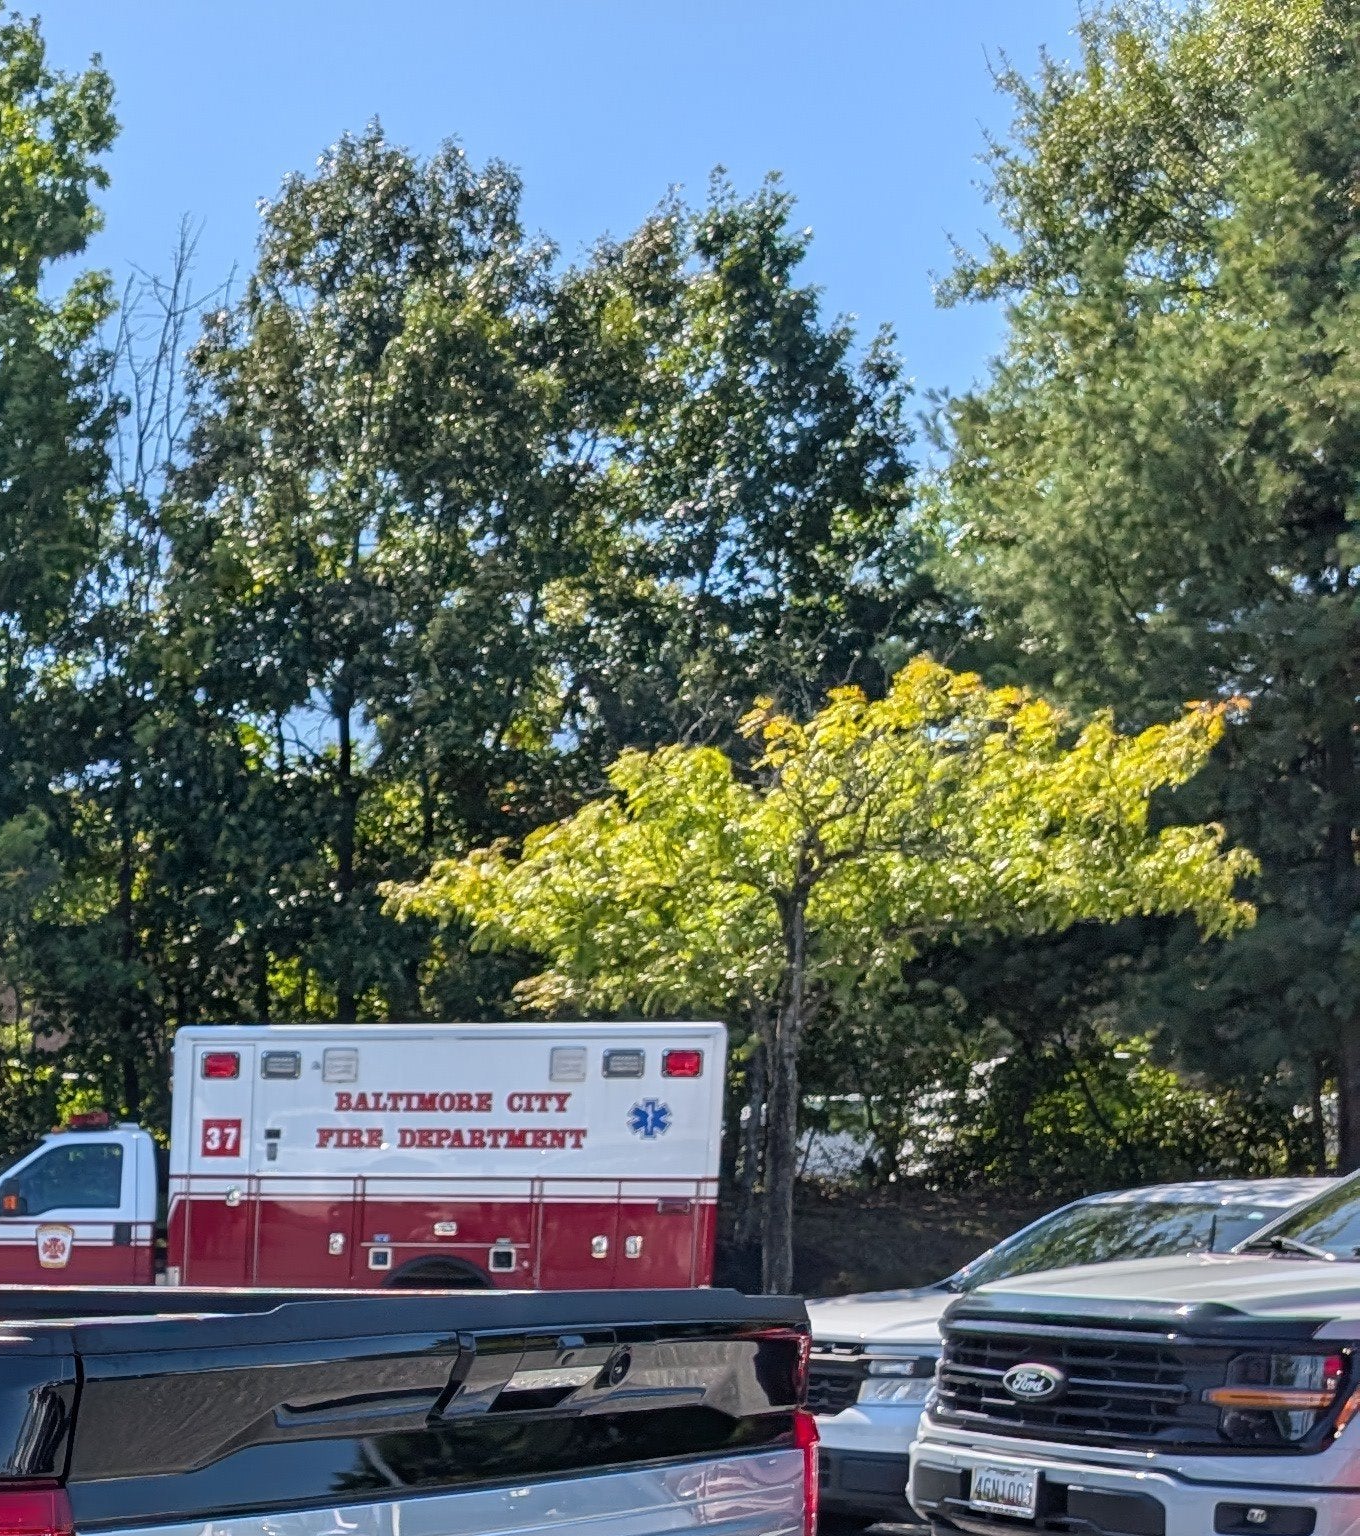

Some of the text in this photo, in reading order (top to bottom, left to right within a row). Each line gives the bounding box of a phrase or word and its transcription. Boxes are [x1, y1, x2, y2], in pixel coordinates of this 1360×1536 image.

[335, 1091, 572, 1113] BALTIMORE CITY
[206, 1127, 237, 1150] 37
[315, 1127, 587, 1150] FIRE DEPARTMENT
[1011, 1371, 1047, 1393] Ford
